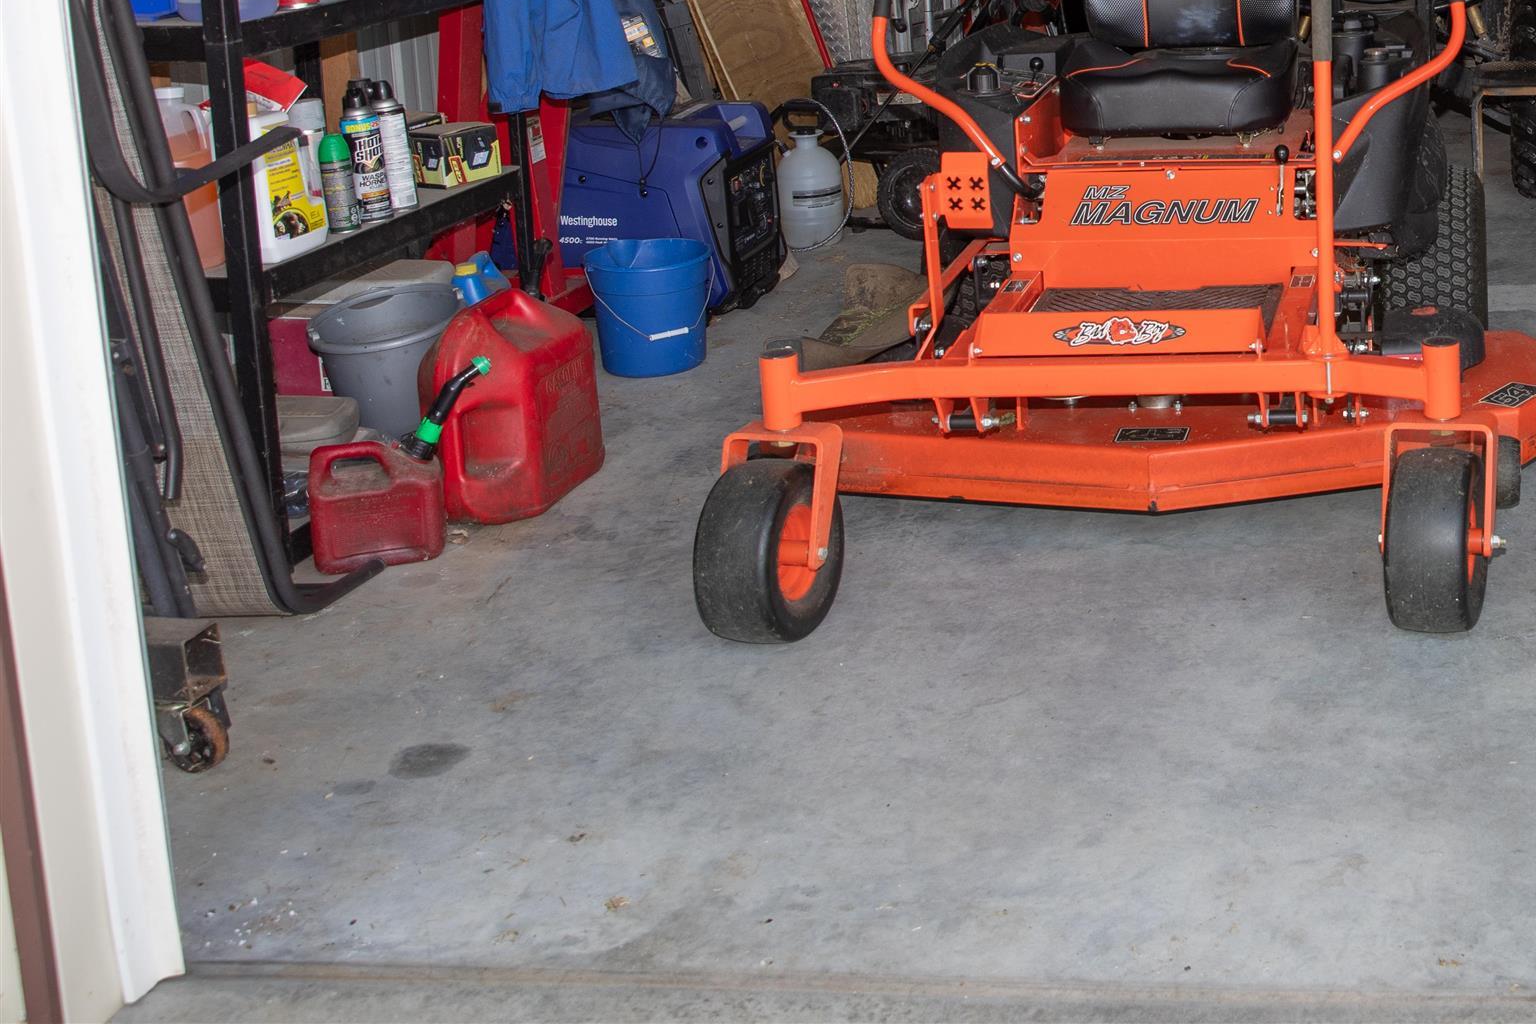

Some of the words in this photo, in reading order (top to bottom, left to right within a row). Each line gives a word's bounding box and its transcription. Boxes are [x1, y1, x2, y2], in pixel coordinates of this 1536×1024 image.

[354, 134, 382, 151] HOT
[359, 177, 386, 188] HORNE
[1083, 185, 1129, 200] MZ
[1071, 197, 1260, 226] MAGNUM
[560, 216, 618, 228] Westinghouse
[1070, 321, 1109, 346] Bad
[1132, 320, 1170, 344] Boy
